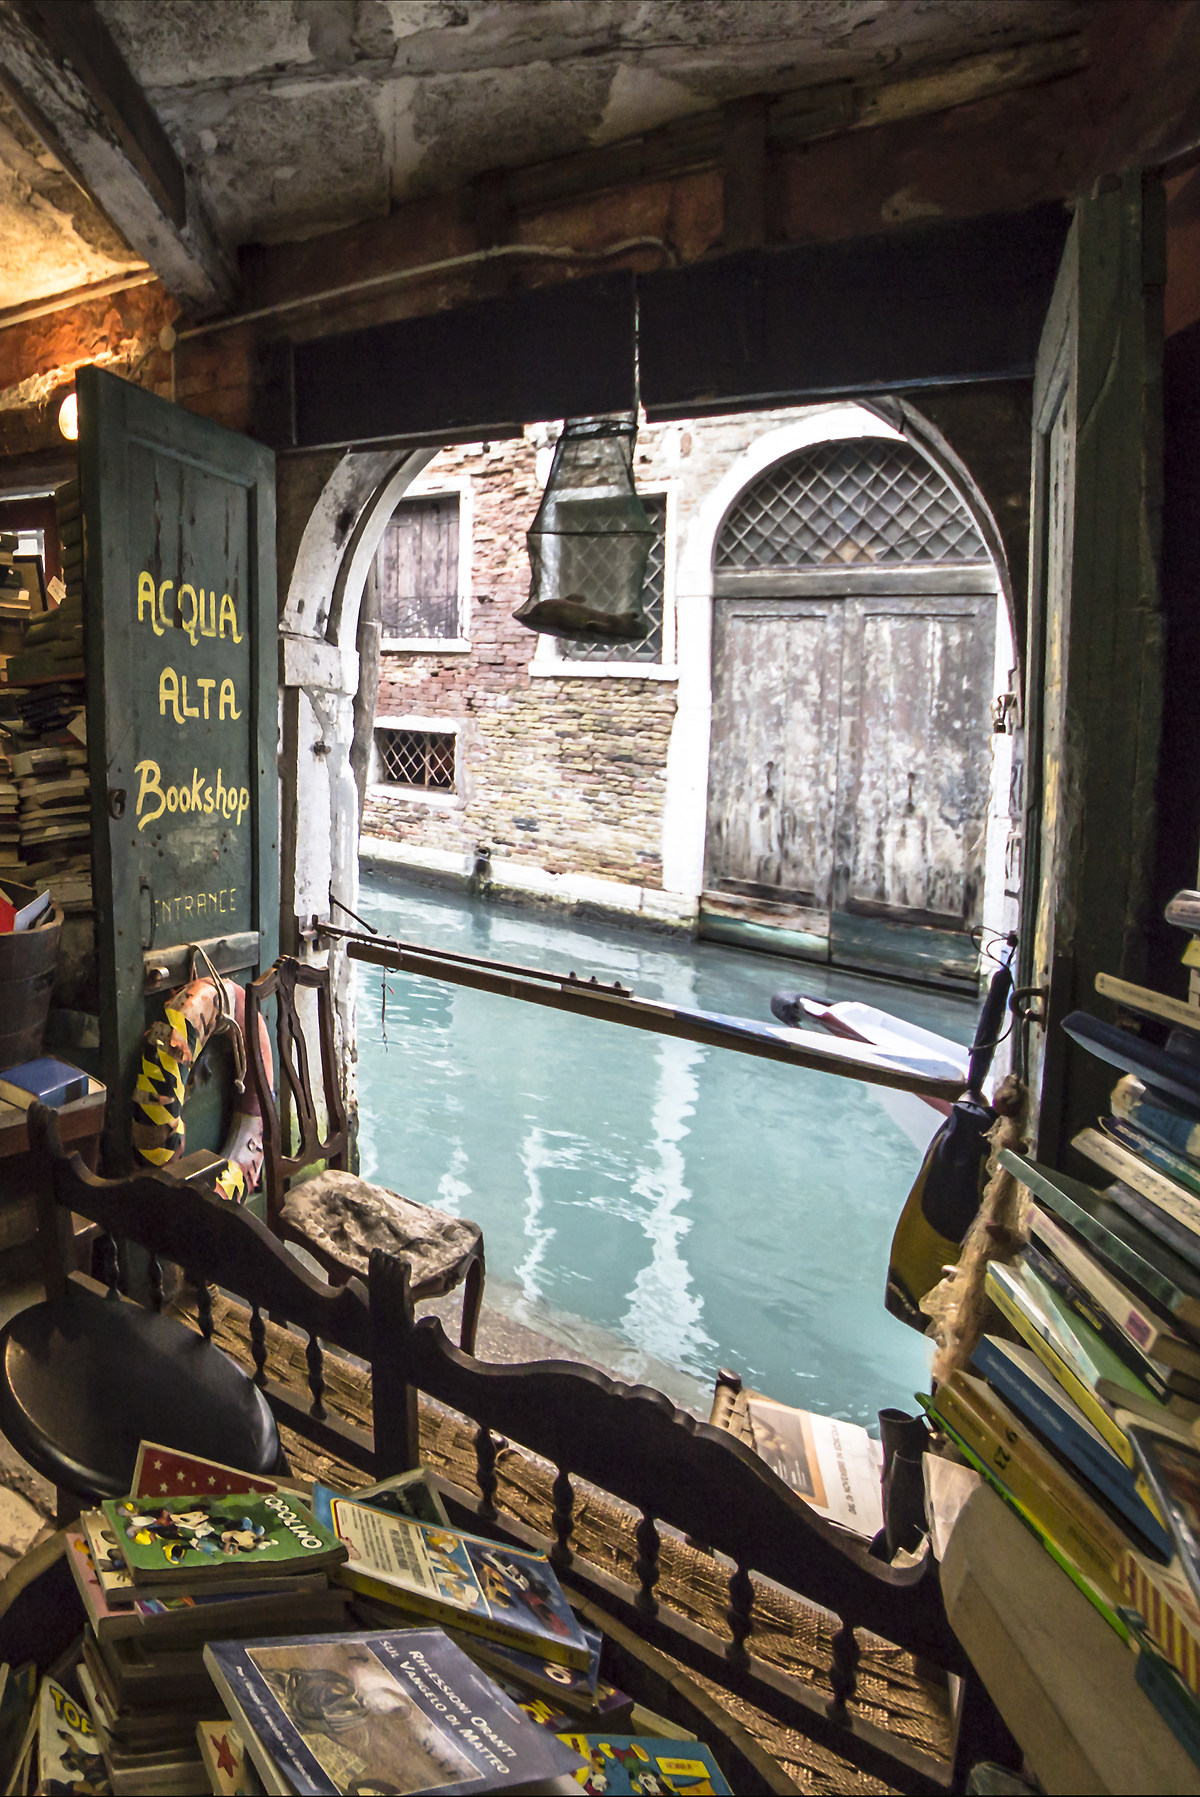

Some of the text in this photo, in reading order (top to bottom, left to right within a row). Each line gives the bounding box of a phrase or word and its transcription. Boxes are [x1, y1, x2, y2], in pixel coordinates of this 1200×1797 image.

[137, 571, 243, 647] ACQUA
[159, 666, 243, 725] ALTA
[134, 759, 250, 832] Bookshop
[261, 1494, 323, 1550] TOPOLINO
[379, 1640, 400, 1660] SUL
[400, 1660, 448, 1712] VANGELO
[445, 1713, 461, 1726] DI
[459, 1728, 510, 1774] MATTEO
[408, 1650, 472, 1714] RIFLESSIONI
[470, 1715, 518, 1758] ORANTI
